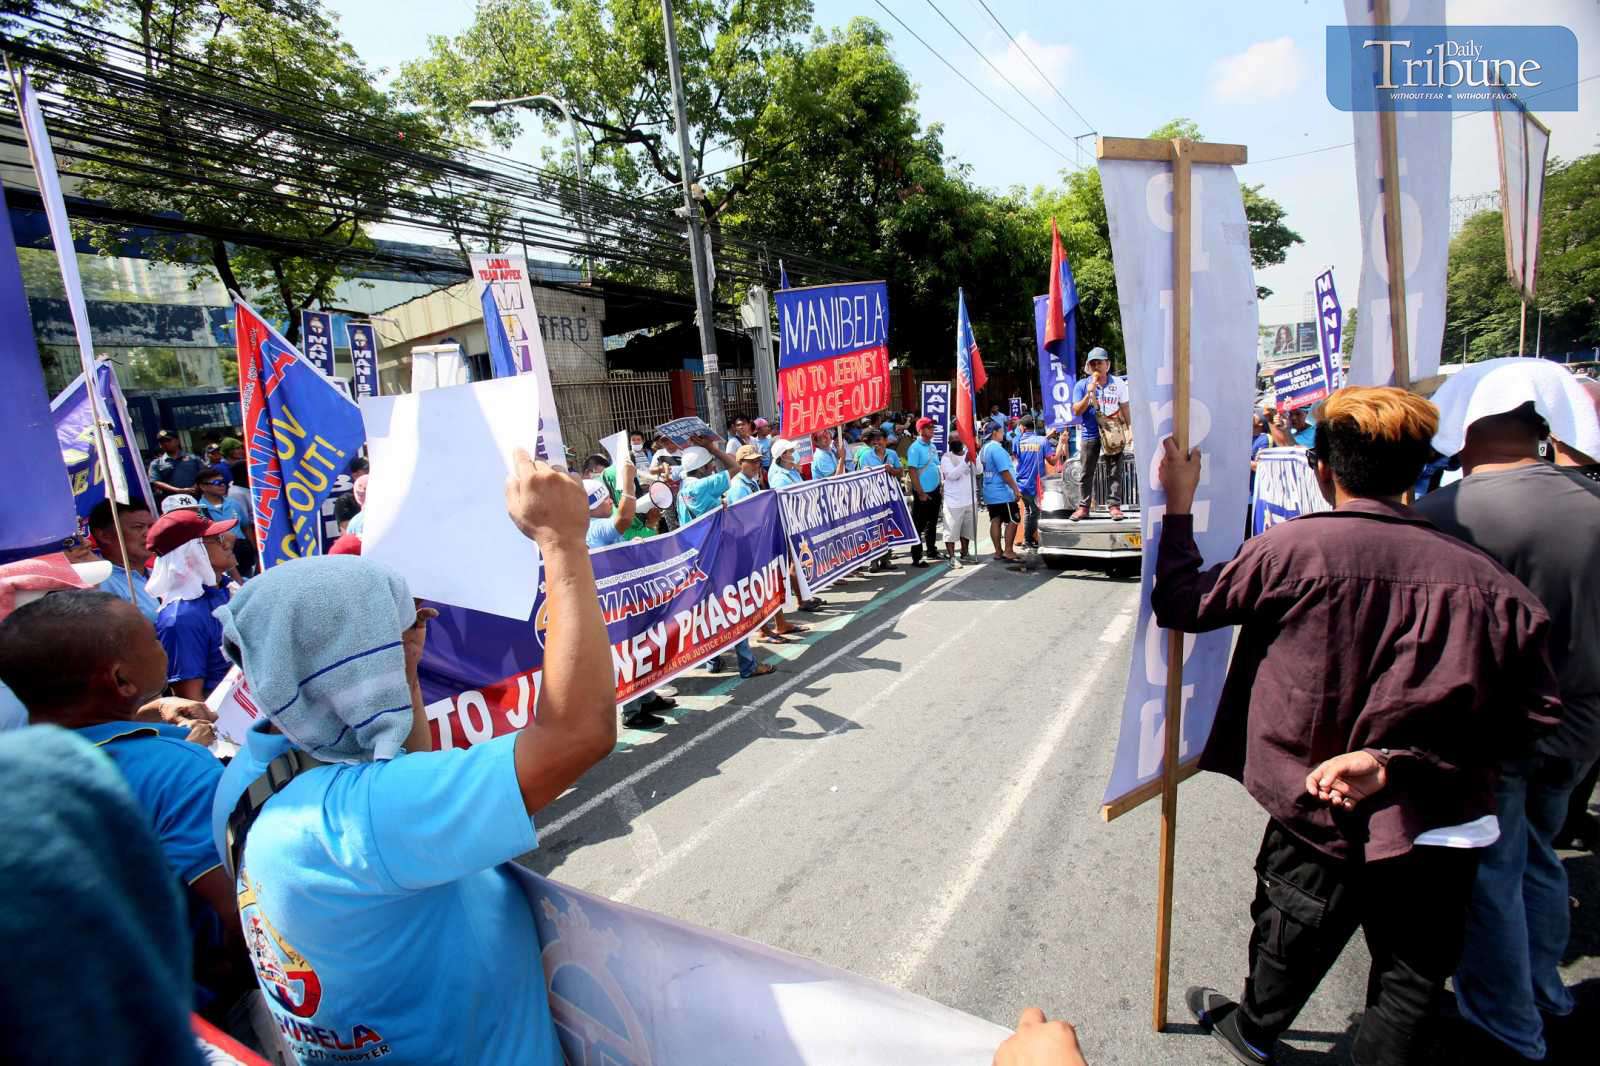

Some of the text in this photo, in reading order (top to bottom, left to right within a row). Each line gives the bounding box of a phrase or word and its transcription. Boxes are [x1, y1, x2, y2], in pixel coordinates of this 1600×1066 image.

[784, 290, 887, 355] MANIBELA
[787, 370, 807, 401] NO
[808, 364, 827, 391] TO
[814, 517, 905, 577] MANIBELA
[597, 558, 709, 625] MANIBELA
[692, 638, 719, 661] JUSTICE
[425, 690, 494, 752] TO
